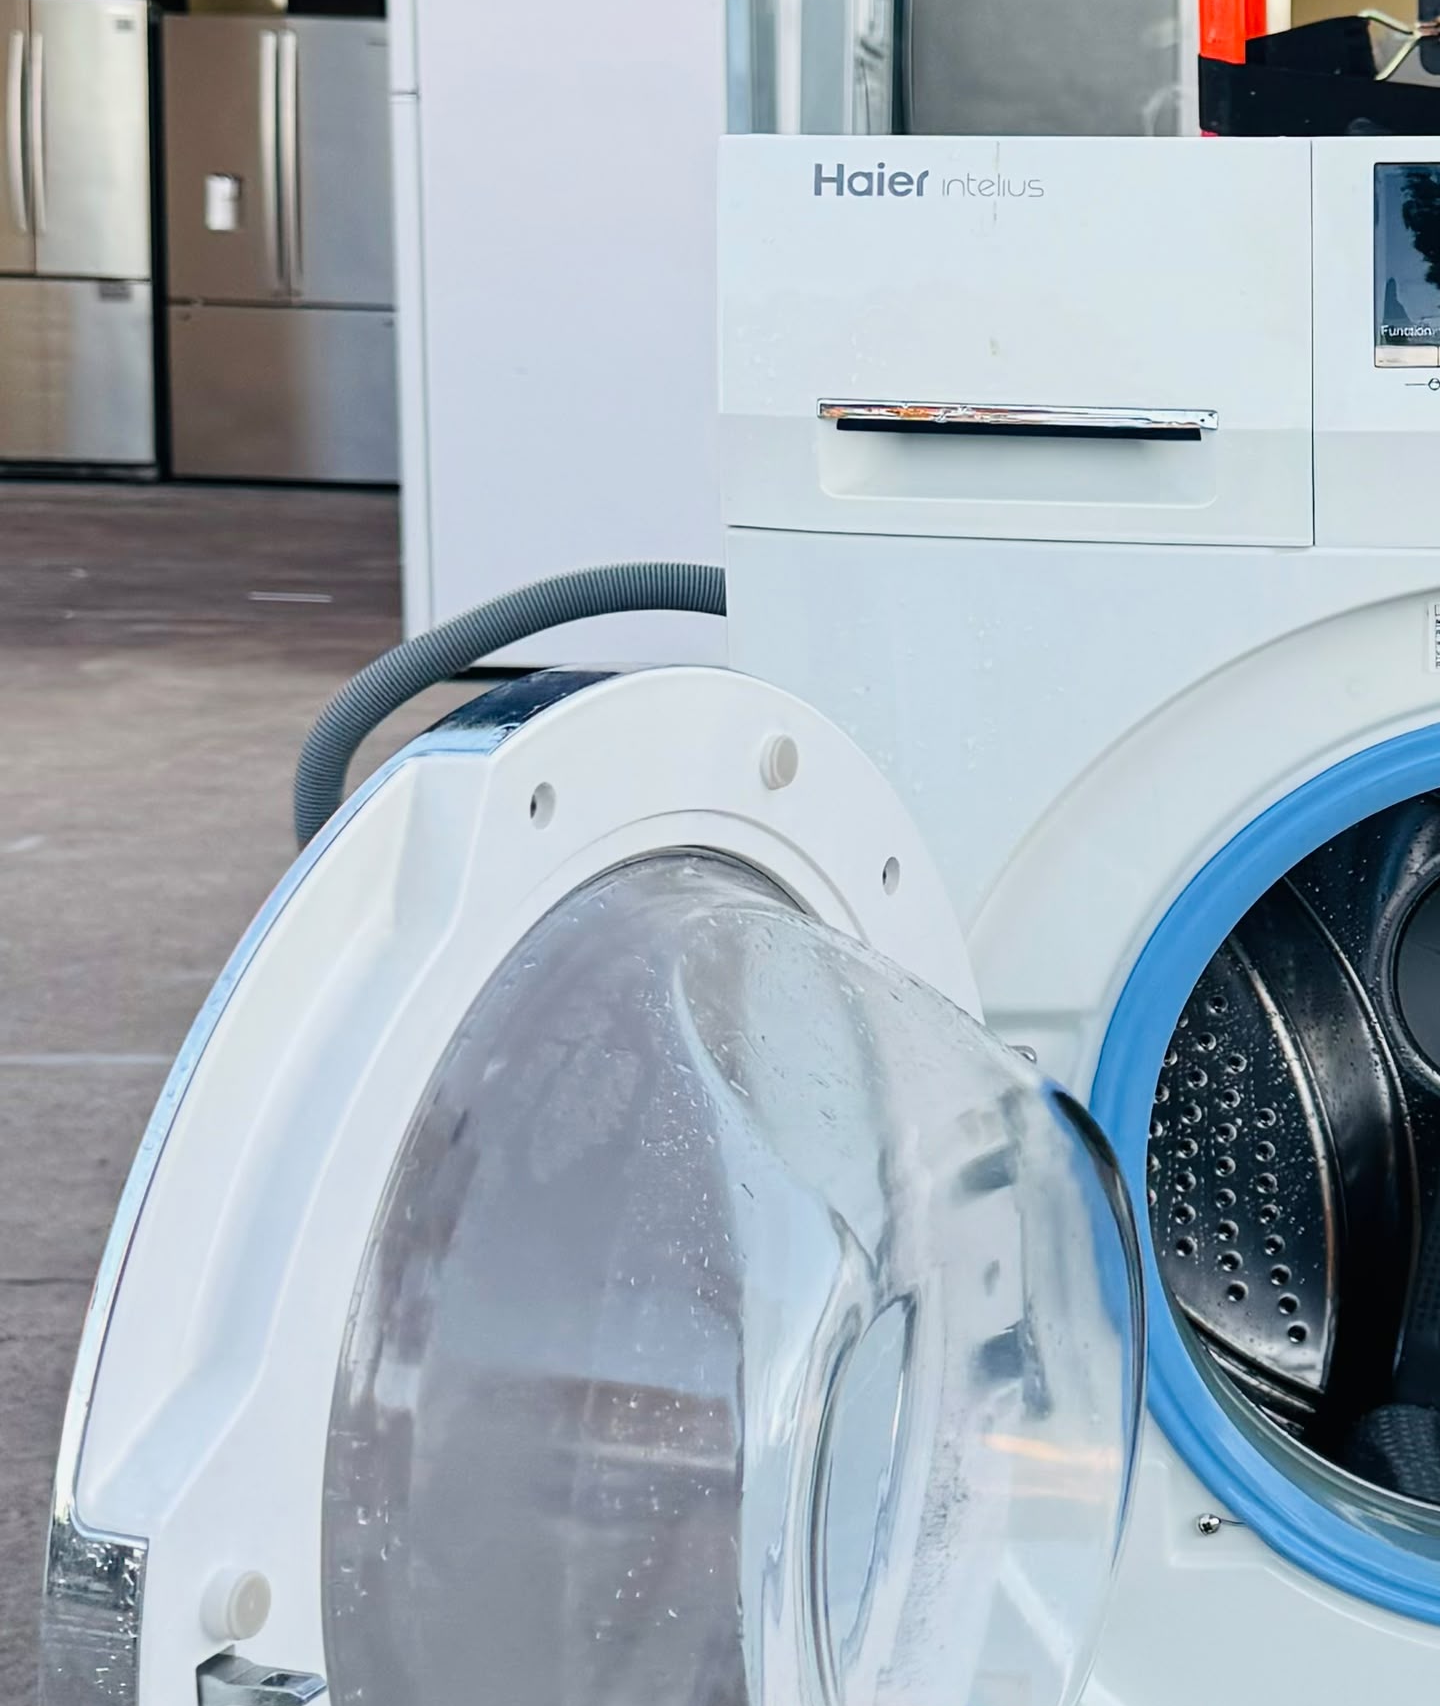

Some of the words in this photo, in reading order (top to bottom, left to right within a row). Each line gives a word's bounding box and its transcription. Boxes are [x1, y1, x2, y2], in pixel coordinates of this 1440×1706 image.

[813, 162, 929, 197] Haier
[942, 173, 1045, 198] intelius
[1380, 325, 1432, 337] Function
